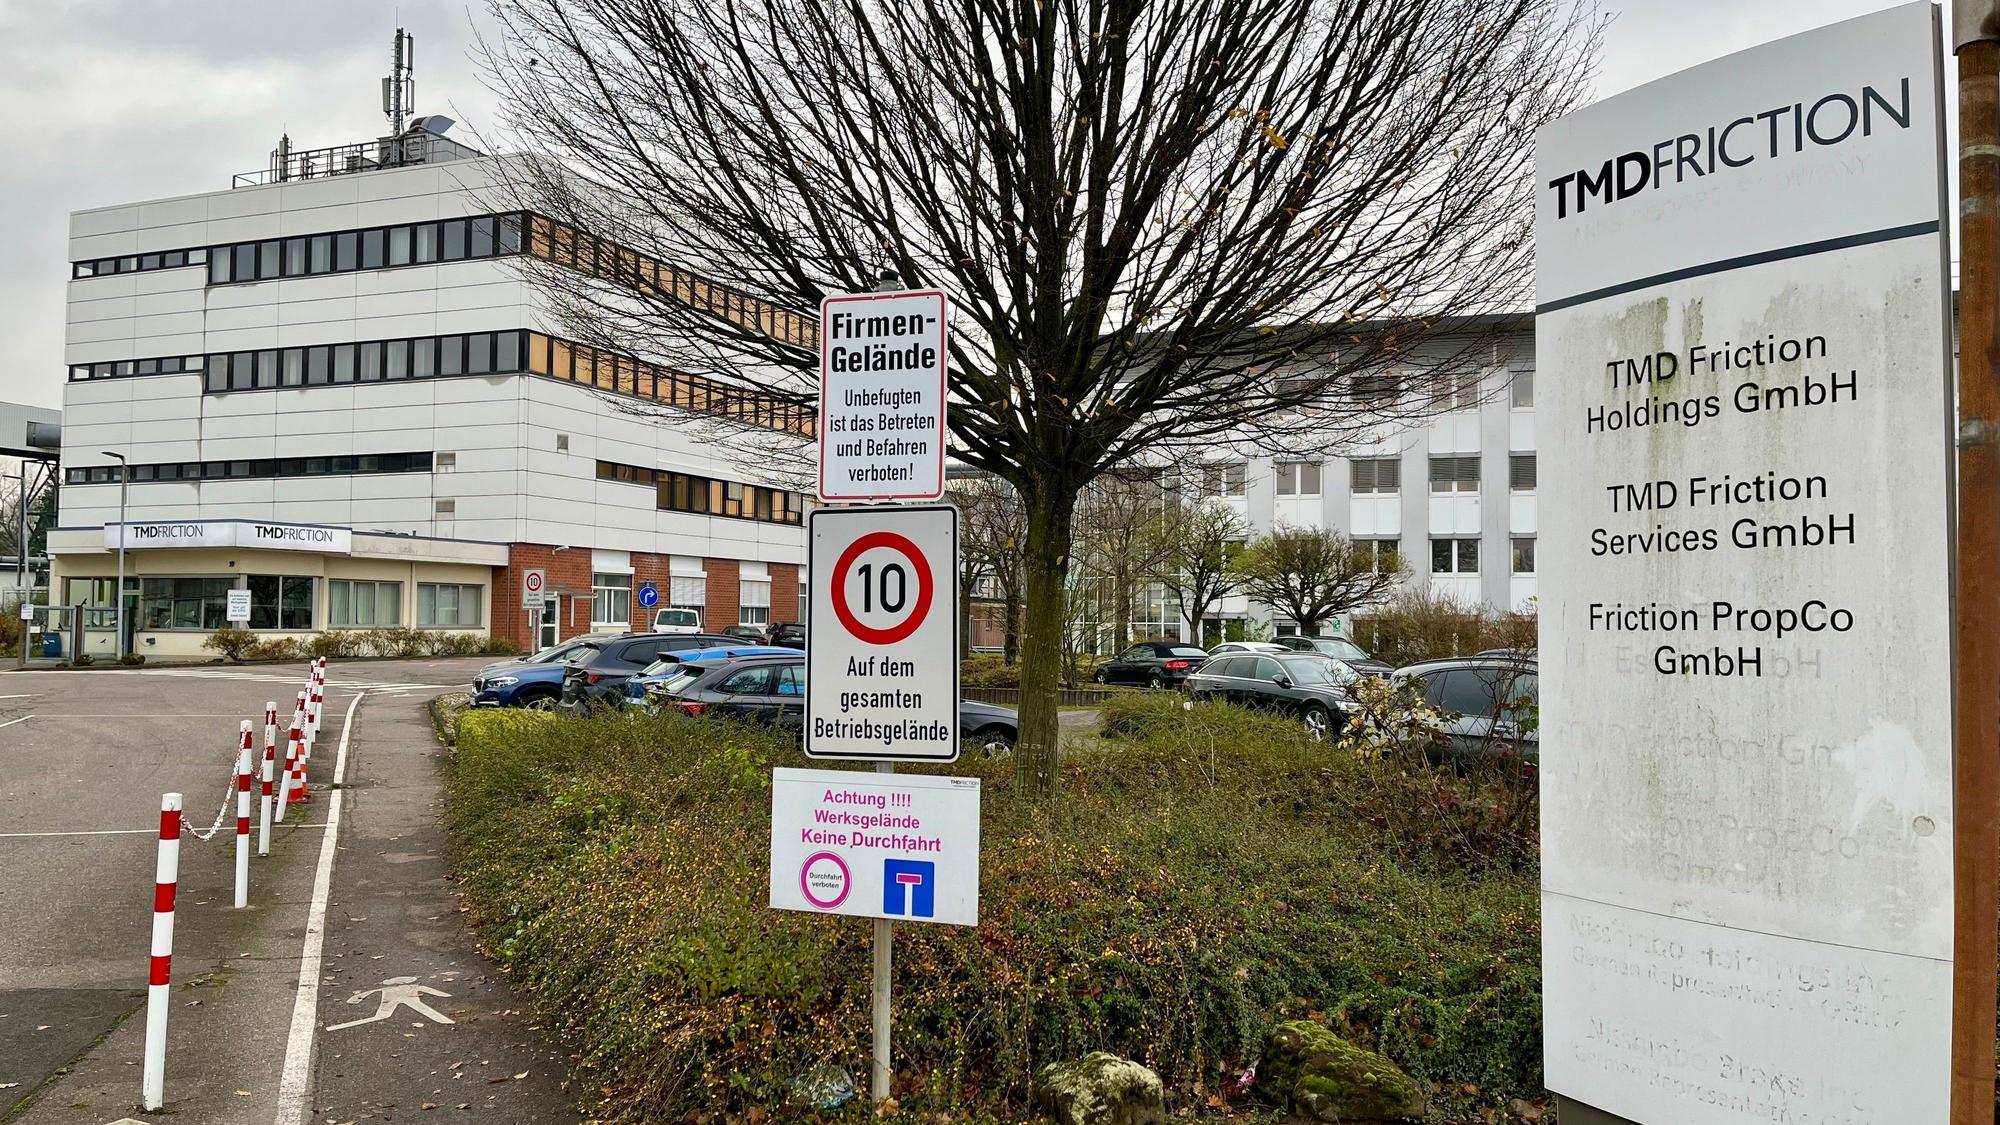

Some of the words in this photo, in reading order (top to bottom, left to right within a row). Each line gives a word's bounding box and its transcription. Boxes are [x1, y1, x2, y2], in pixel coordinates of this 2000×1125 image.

[1549, 77, 1910, 219] TMDFRICTION
[833, 313, 935, 339] Firmen-
[832, 343, 935, 372] Gelände
[1607, 352, 1678, 388] TMD
[1690, 335, 1826, 374] Friction
[845, 388, 920, 409] Unbefugten
[1588, 396, 1719, 433] Holdings
[1734, 370, 1857, 412] GmbH
[831, 415, 846, 432] ist
[851, 414, 873, 431] das
[879, 413, 934, 430] Betreten
[837, 439, 861, 456] und
[867, 438, 926, 456] Befahren
[849, 463, 913, 481] verboten!
[1607, 481, 1677, 512] TMD
[1691, 471, 1826, 506] Friction
[133, 525, 204, 539] TMDFRICTION
[254, 526, 333, 543] TMDFRICTION
[1592, 525, 1717, 555] Services
[1732, 514, 1854, 548] GmbH
[530, 578, 538, 586] 10
[858, 563, 905, 613] 10
[1590, 603, 1697, 631] Friction
[1713, 600, 1853, 638] PropCo
[847, 656, 874, 676] Auf
[881, 656, 913, 676] dem
[1655, 646, 1761, 676] GmbH
[841, 689, 921, 713] gesamten
[815, 718, 948, 745] Betriebsgelände
[824, 790, 885, 809] Achtung
[815, 808, 919, 829] Werksgelände
[802, 829, 846, 845] Keine
[852, 832, 940, 853] Durchfahrt
[809, 872, 842, 881] Durchfahrt
